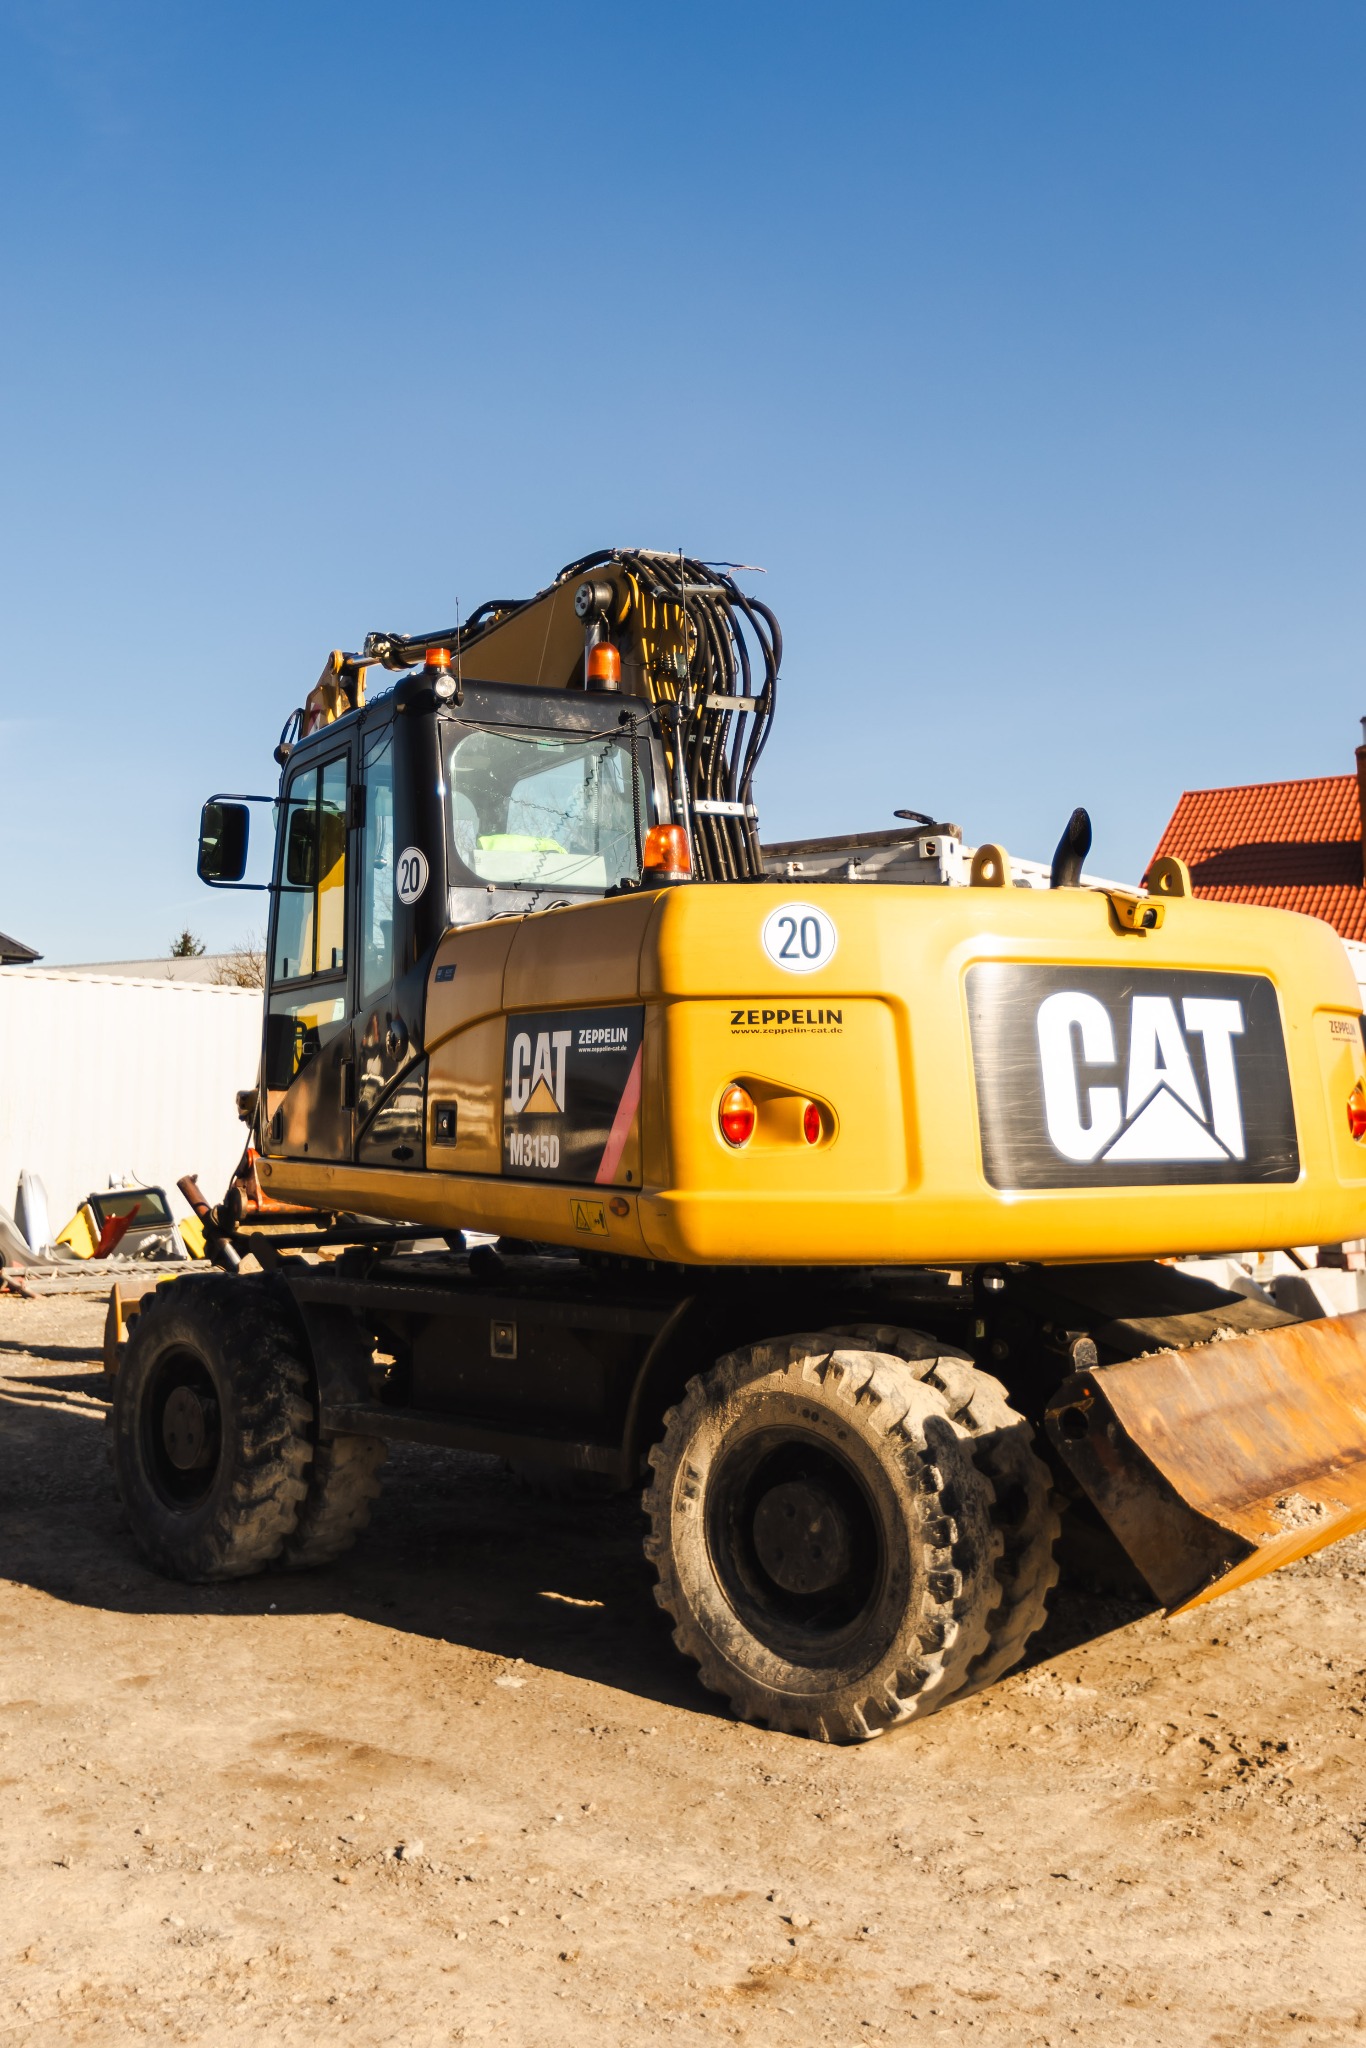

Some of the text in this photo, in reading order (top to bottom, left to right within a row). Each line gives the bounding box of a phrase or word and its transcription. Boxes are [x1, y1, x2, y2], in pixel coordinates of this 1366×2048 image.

[401, 857, 420, 894] 20
[778, 916, 822, 959] 20
[730, 1009, 842, 1025] ZEPPELIN
[731, 1027, 843, 1035] www.zeppelin-cat.de
[578, 1027, 628, 1045] ZEPPELIN
[511, 1030, 572, 1113] CAT
[1037, 991, 1246, 1161] CAT
[510, 1133, 560, 1169] M315D
